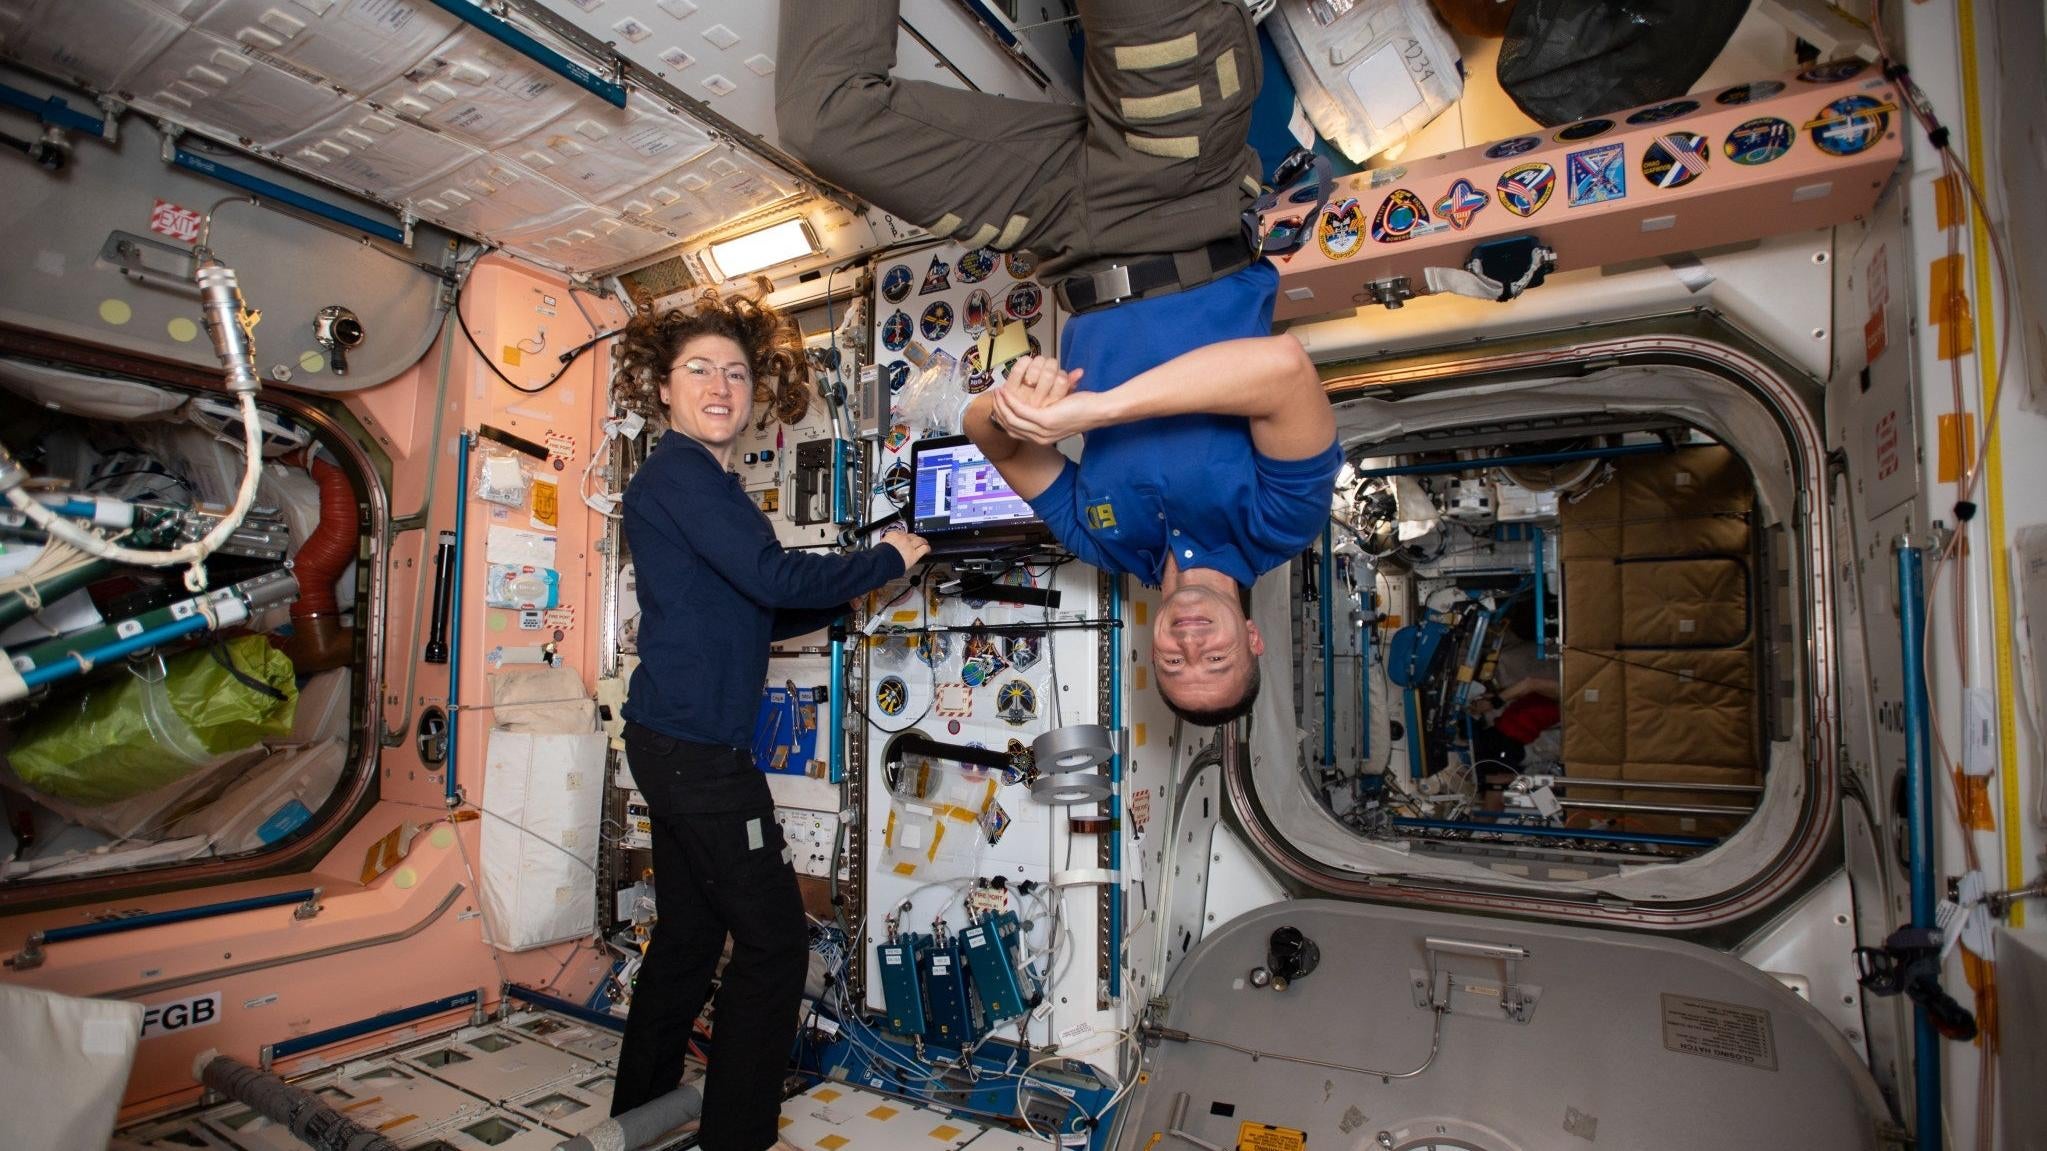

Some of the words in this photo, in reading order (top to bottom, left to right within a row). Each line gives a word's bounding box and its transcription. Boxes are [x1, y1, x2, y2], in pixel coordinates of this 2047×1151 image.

[1771, 122, 1786, 137] 11
[160, 208, 194, 233] EXIT
[975, 891, 987, 899] FIRE
[141, 998, 215, 1037] FGB
[1680, 1042, 1712, 1054] HATCH
[1713, 1048, 1755, 1063] CLOSING
